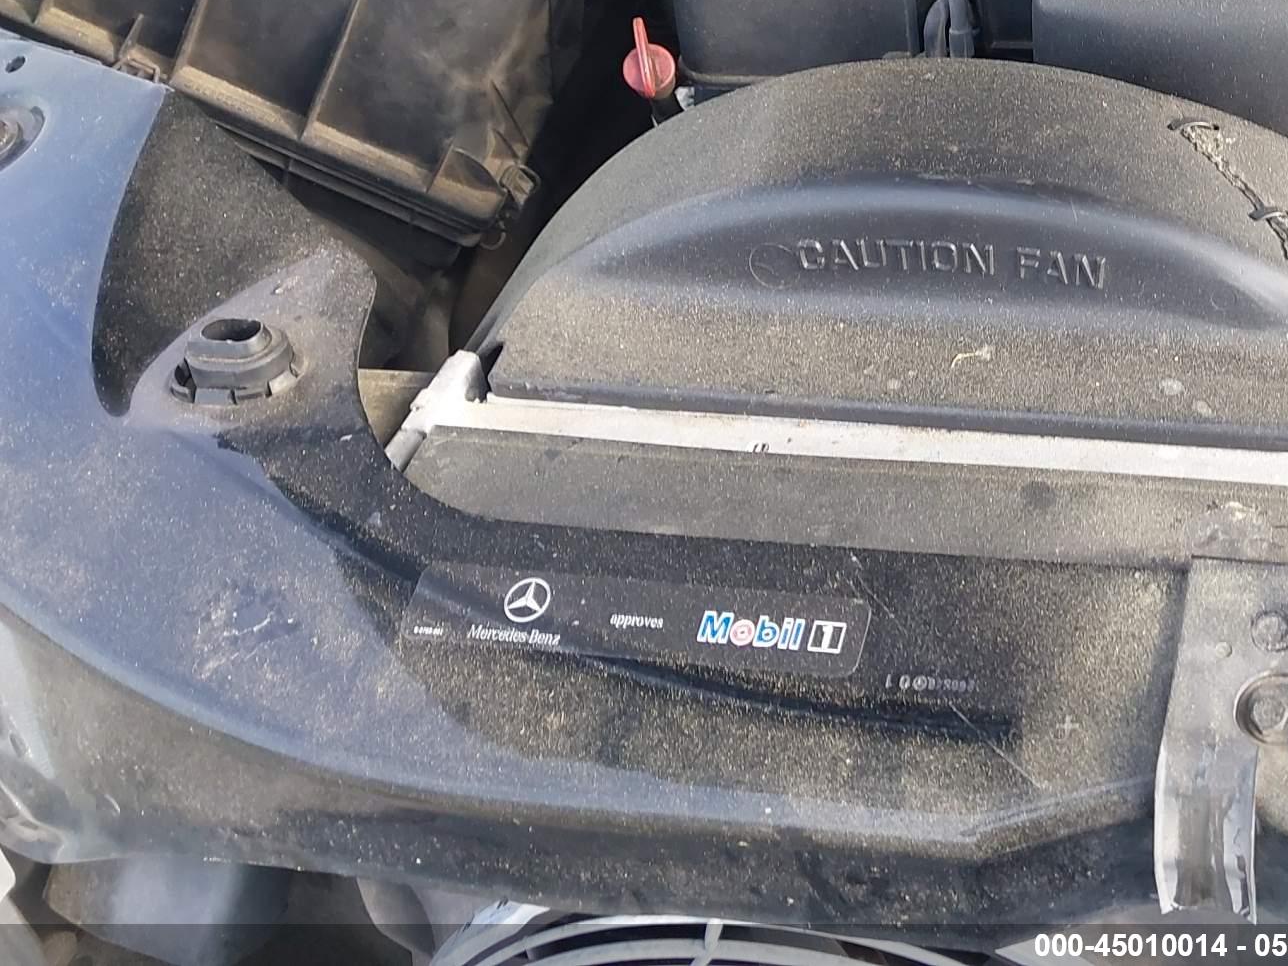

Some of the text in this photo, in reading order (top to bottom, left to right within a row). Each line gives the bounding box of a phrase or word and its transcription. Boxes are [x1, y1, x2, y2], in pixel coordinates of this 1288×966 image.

[797, 237, 1107, 290] CAUTION FAN
[466, 623, 561, 646] Mercedes-Benz
[609, 612, 664, 629] approves
[696, 610, 806, 651] Mobil
